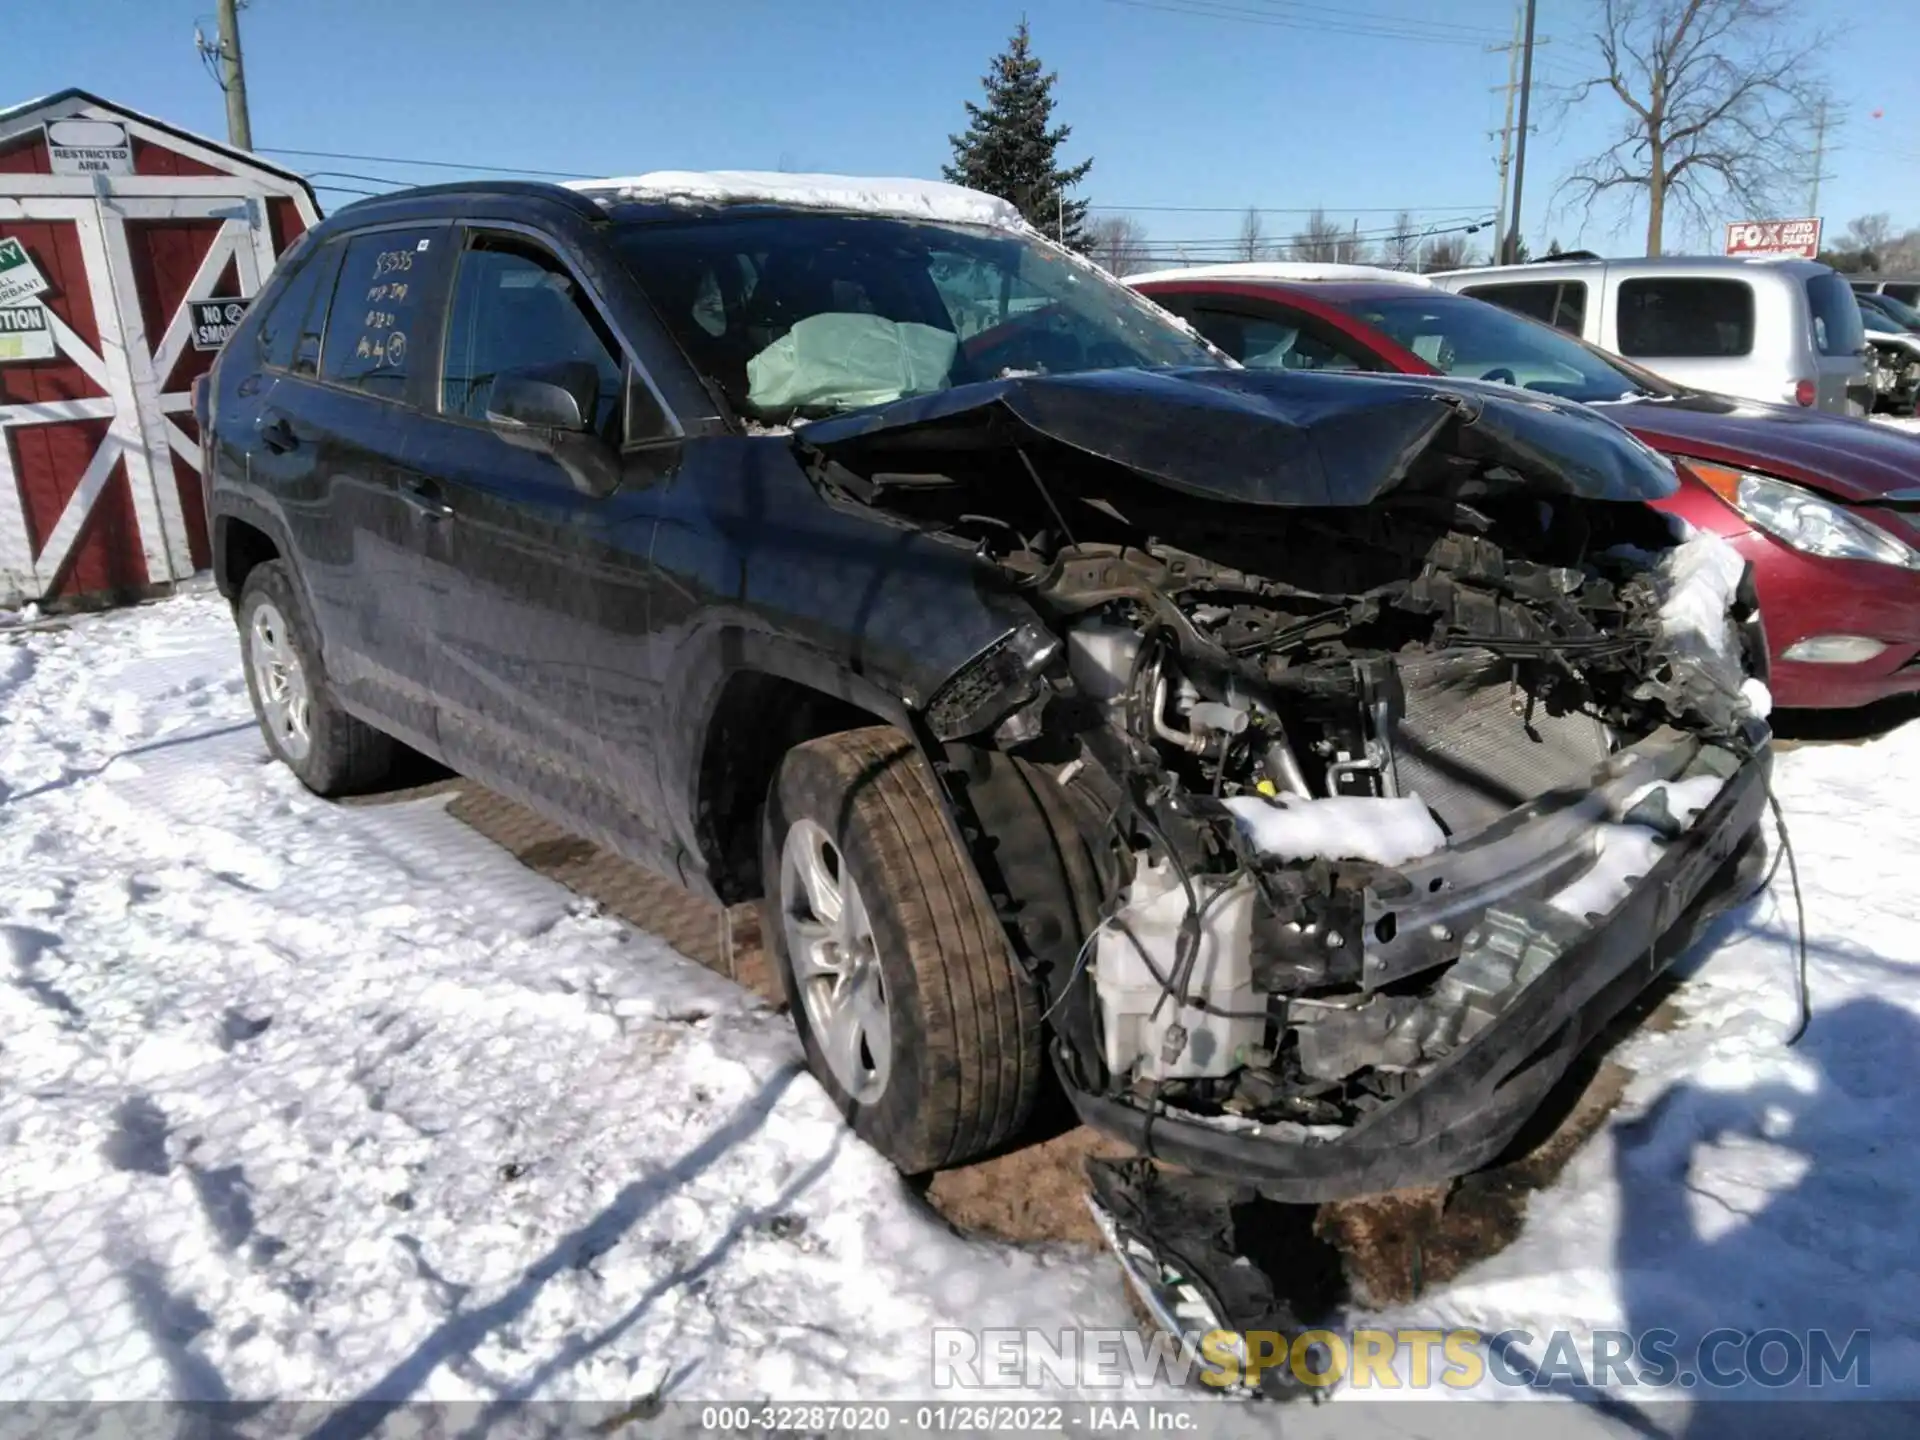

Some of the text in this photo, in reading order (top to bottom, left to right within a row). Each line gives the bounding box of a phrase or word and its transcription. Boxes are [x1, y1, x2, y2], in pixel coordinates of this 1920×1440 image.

[53, 149, 128, 160] RESTRICTED
[78, 161, 110, 171] AREA
[1729, 222, 1781, 248] FOX
[1783, 222, 1814, 234] AUTO
[1782, 233, 1815, 246] PARTS
[0, 278, 40, 302] RBANT
[0, 308, 43, 330] TION
[202, 305, 221, 324] NO
